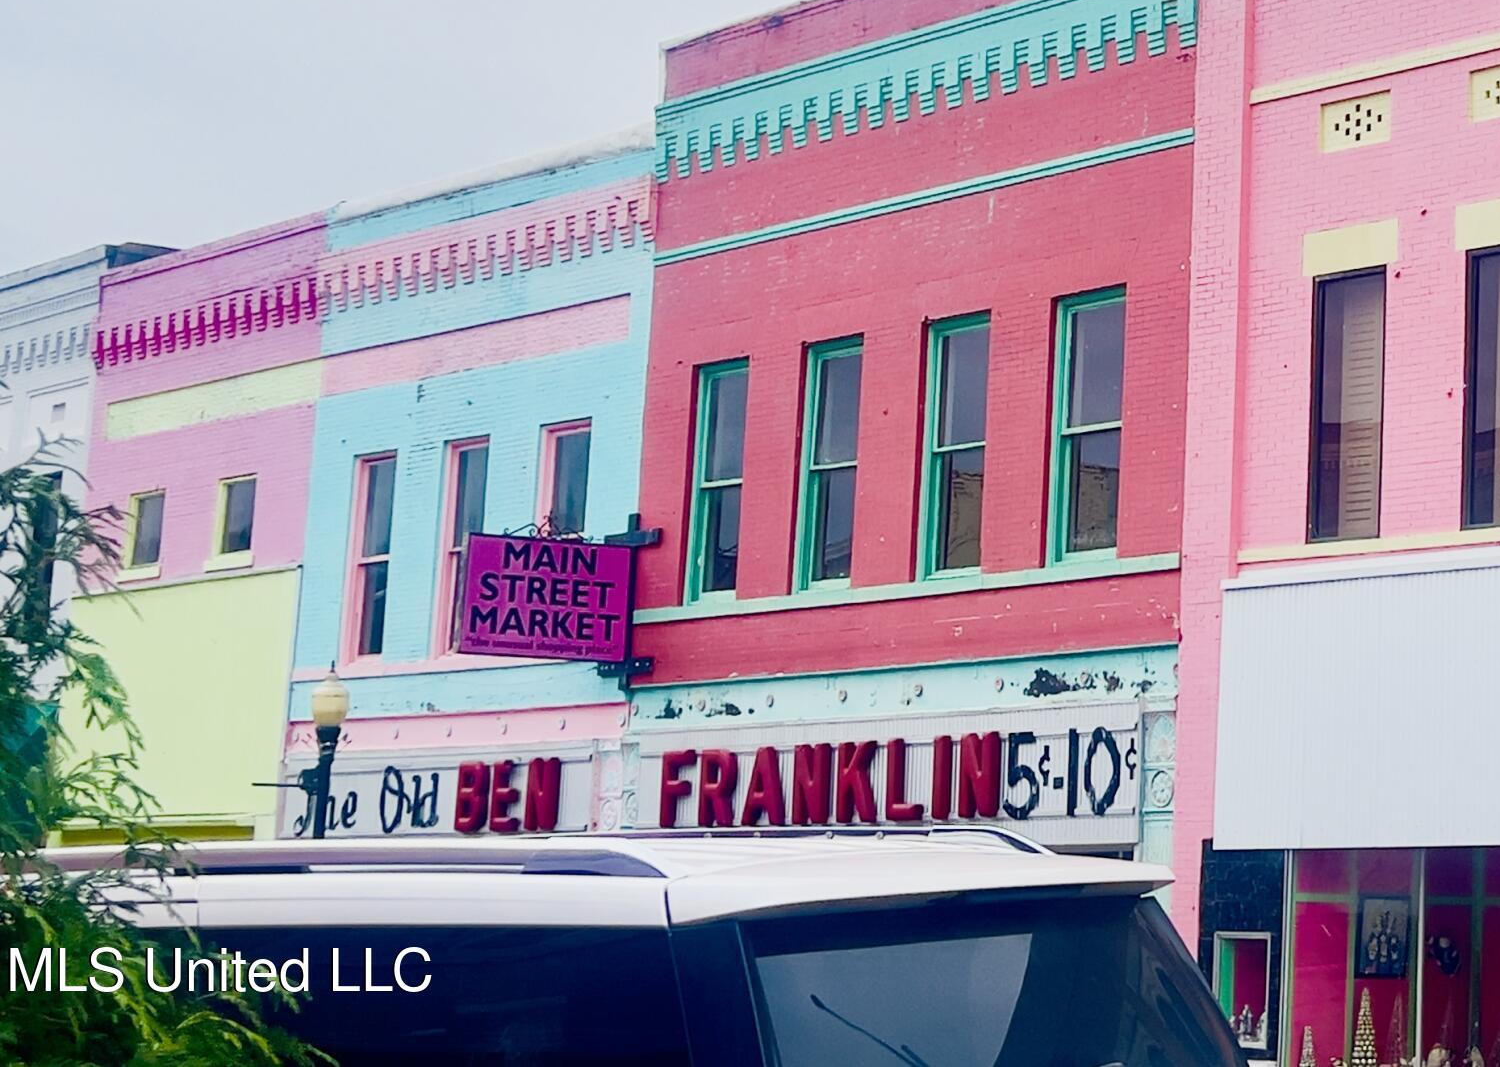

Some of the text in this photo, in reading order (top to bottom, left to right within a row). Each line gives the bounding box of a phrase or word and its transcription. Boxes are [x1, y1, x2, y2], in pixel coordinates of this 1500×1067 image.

[503, 541, 598, 576] MAIN
[479, 572, 616, 609] STREET
[469, 605, 621, 642] MARKET
[535, 640, 583, 656] shopping
[380, 765, 439, 834] Old
[454, 757, 562, 834] BEN
[659, 731, 1001, 829] FRANKLIN
